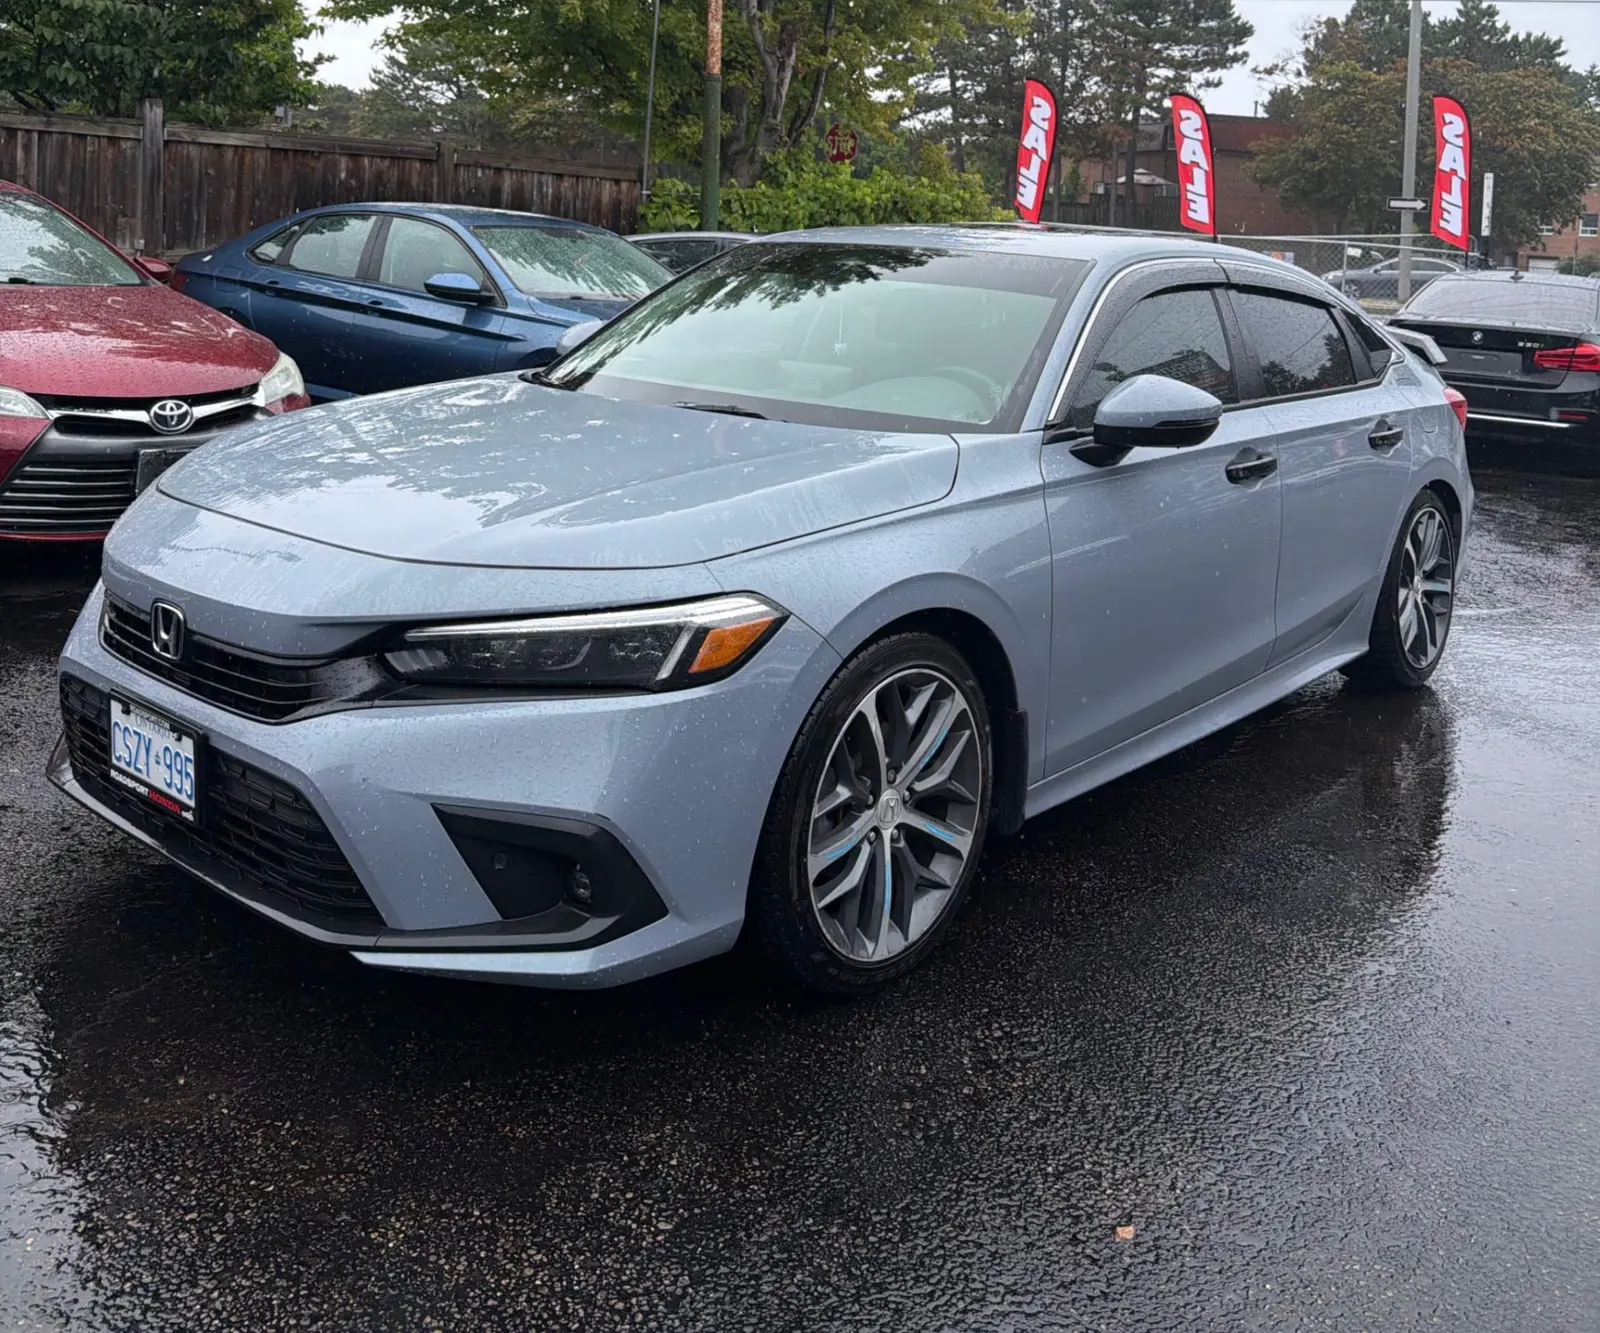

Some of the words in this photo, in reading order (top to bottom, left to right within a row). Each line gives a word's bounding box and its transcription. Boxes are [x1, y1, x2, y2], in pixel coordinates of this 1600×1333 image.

[110, 768, 149, 797] ROADSPORT
[149, 789, 182, 815] HONDA
[112, 720, 152, 779] CSZY
[163, 744, 194, 801] 995
